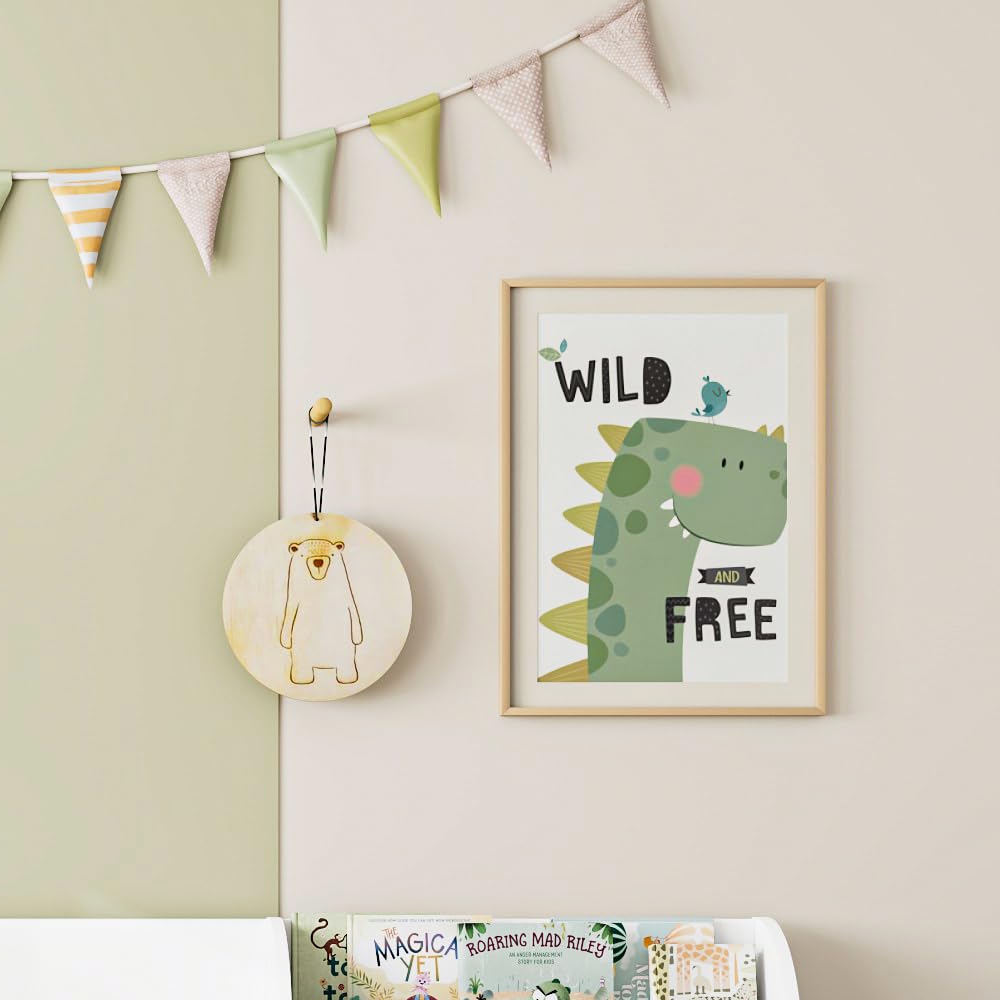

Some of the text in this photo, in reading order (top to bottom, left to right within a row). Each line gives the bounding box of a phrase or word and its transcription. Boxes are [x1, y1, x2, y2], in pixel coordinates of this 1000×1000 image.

[555, 355, 672, 405] WILD
[714, 570, 740, 584] AND
[665, 596, 777, 643] FREE
[382, 926, 398, 938] THE
[465, 931, 607, 959] ROARING MAD RILEY
[400, 954, 443, 982] YET
